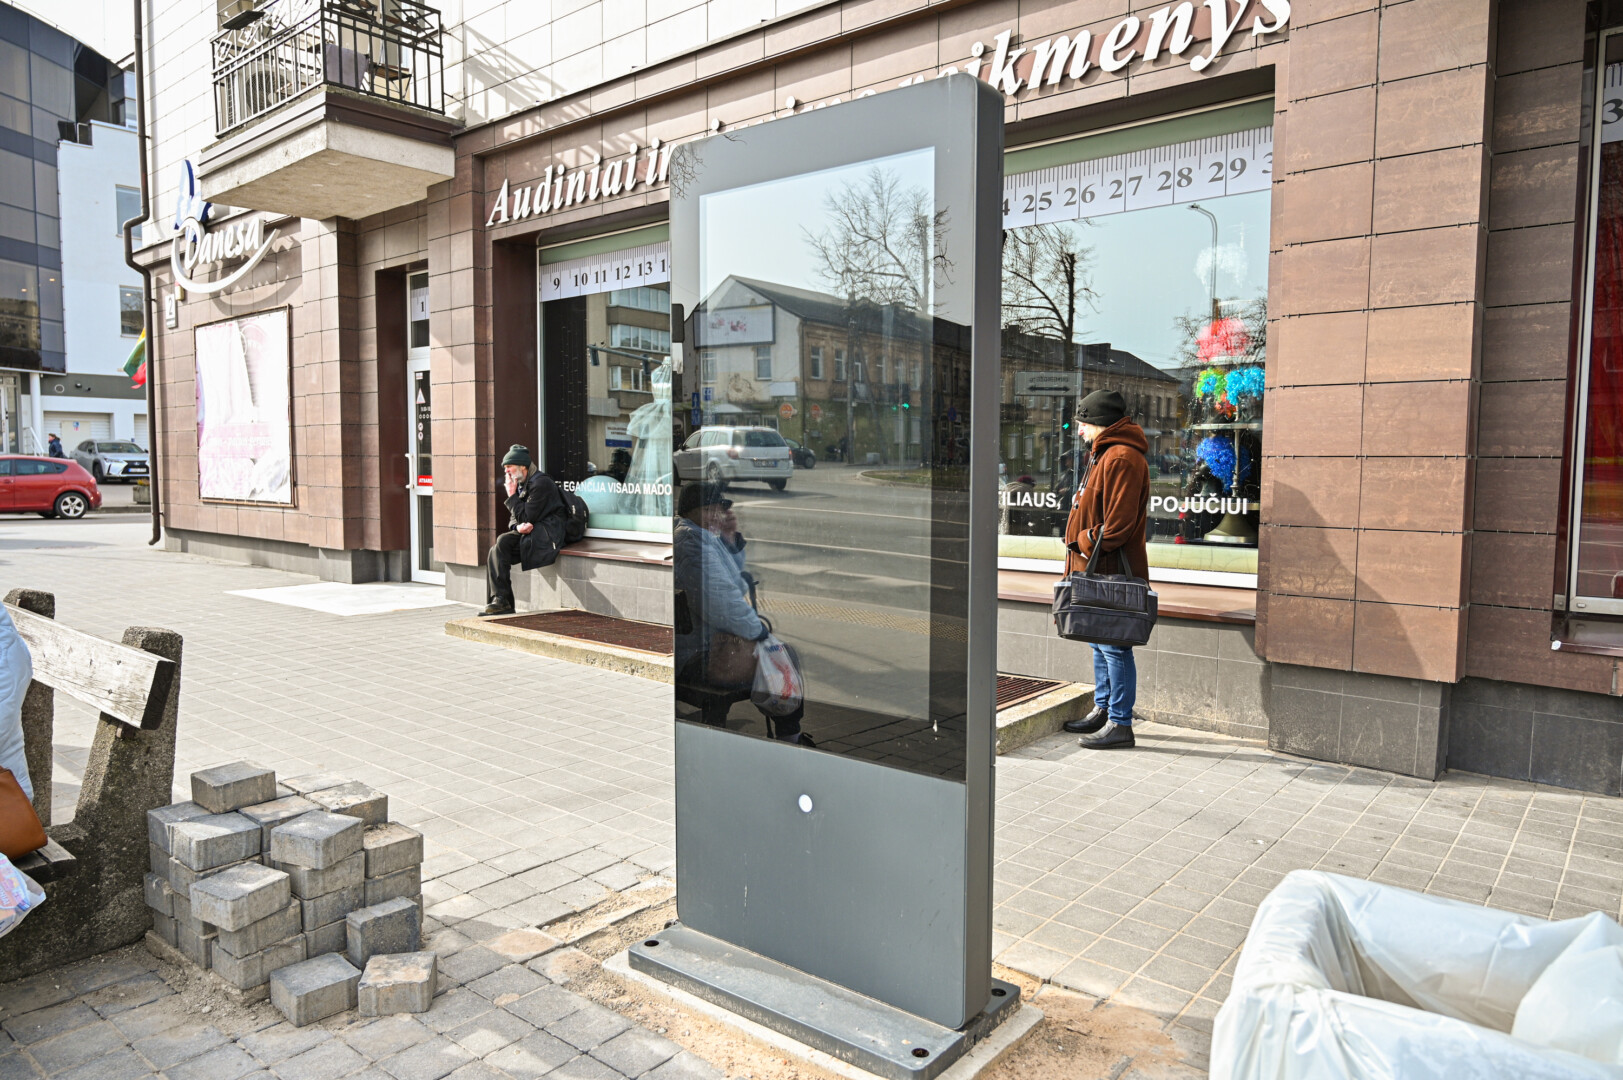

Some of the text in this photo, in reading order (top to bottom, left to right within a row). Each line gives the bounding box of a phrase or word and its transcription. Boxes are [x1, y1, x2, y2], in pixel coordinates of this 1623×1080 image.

[485, 143, 638, 227] Audiniai
[899, 0, 1291, 95] ikmenys
[1022, 191, 1053, 214] 25
[1063, 183, 1096, 207] 26
[1108, 175, 1143, 200] 27
[1156, 166, 1193, 191] 28
[1208, 157, 1248, 184] 29
[177, 216, 264, 270] Danesa
[553, 277, 560, 290] 9
[573, 272, 589, 287] 10
[594, 269, 607, 284] 11
[615, 265, 631, 281] 12
[637, 261, 653, 276] 13
[168, 298, 174, 315] 2
[608, 482, 641, 494] VISADA
[643, 483, 672, 495] MADO
[998, 491, 1061, 510] ILIAUS,
[1150, 493, 1248, 515] POJŪČIUI
